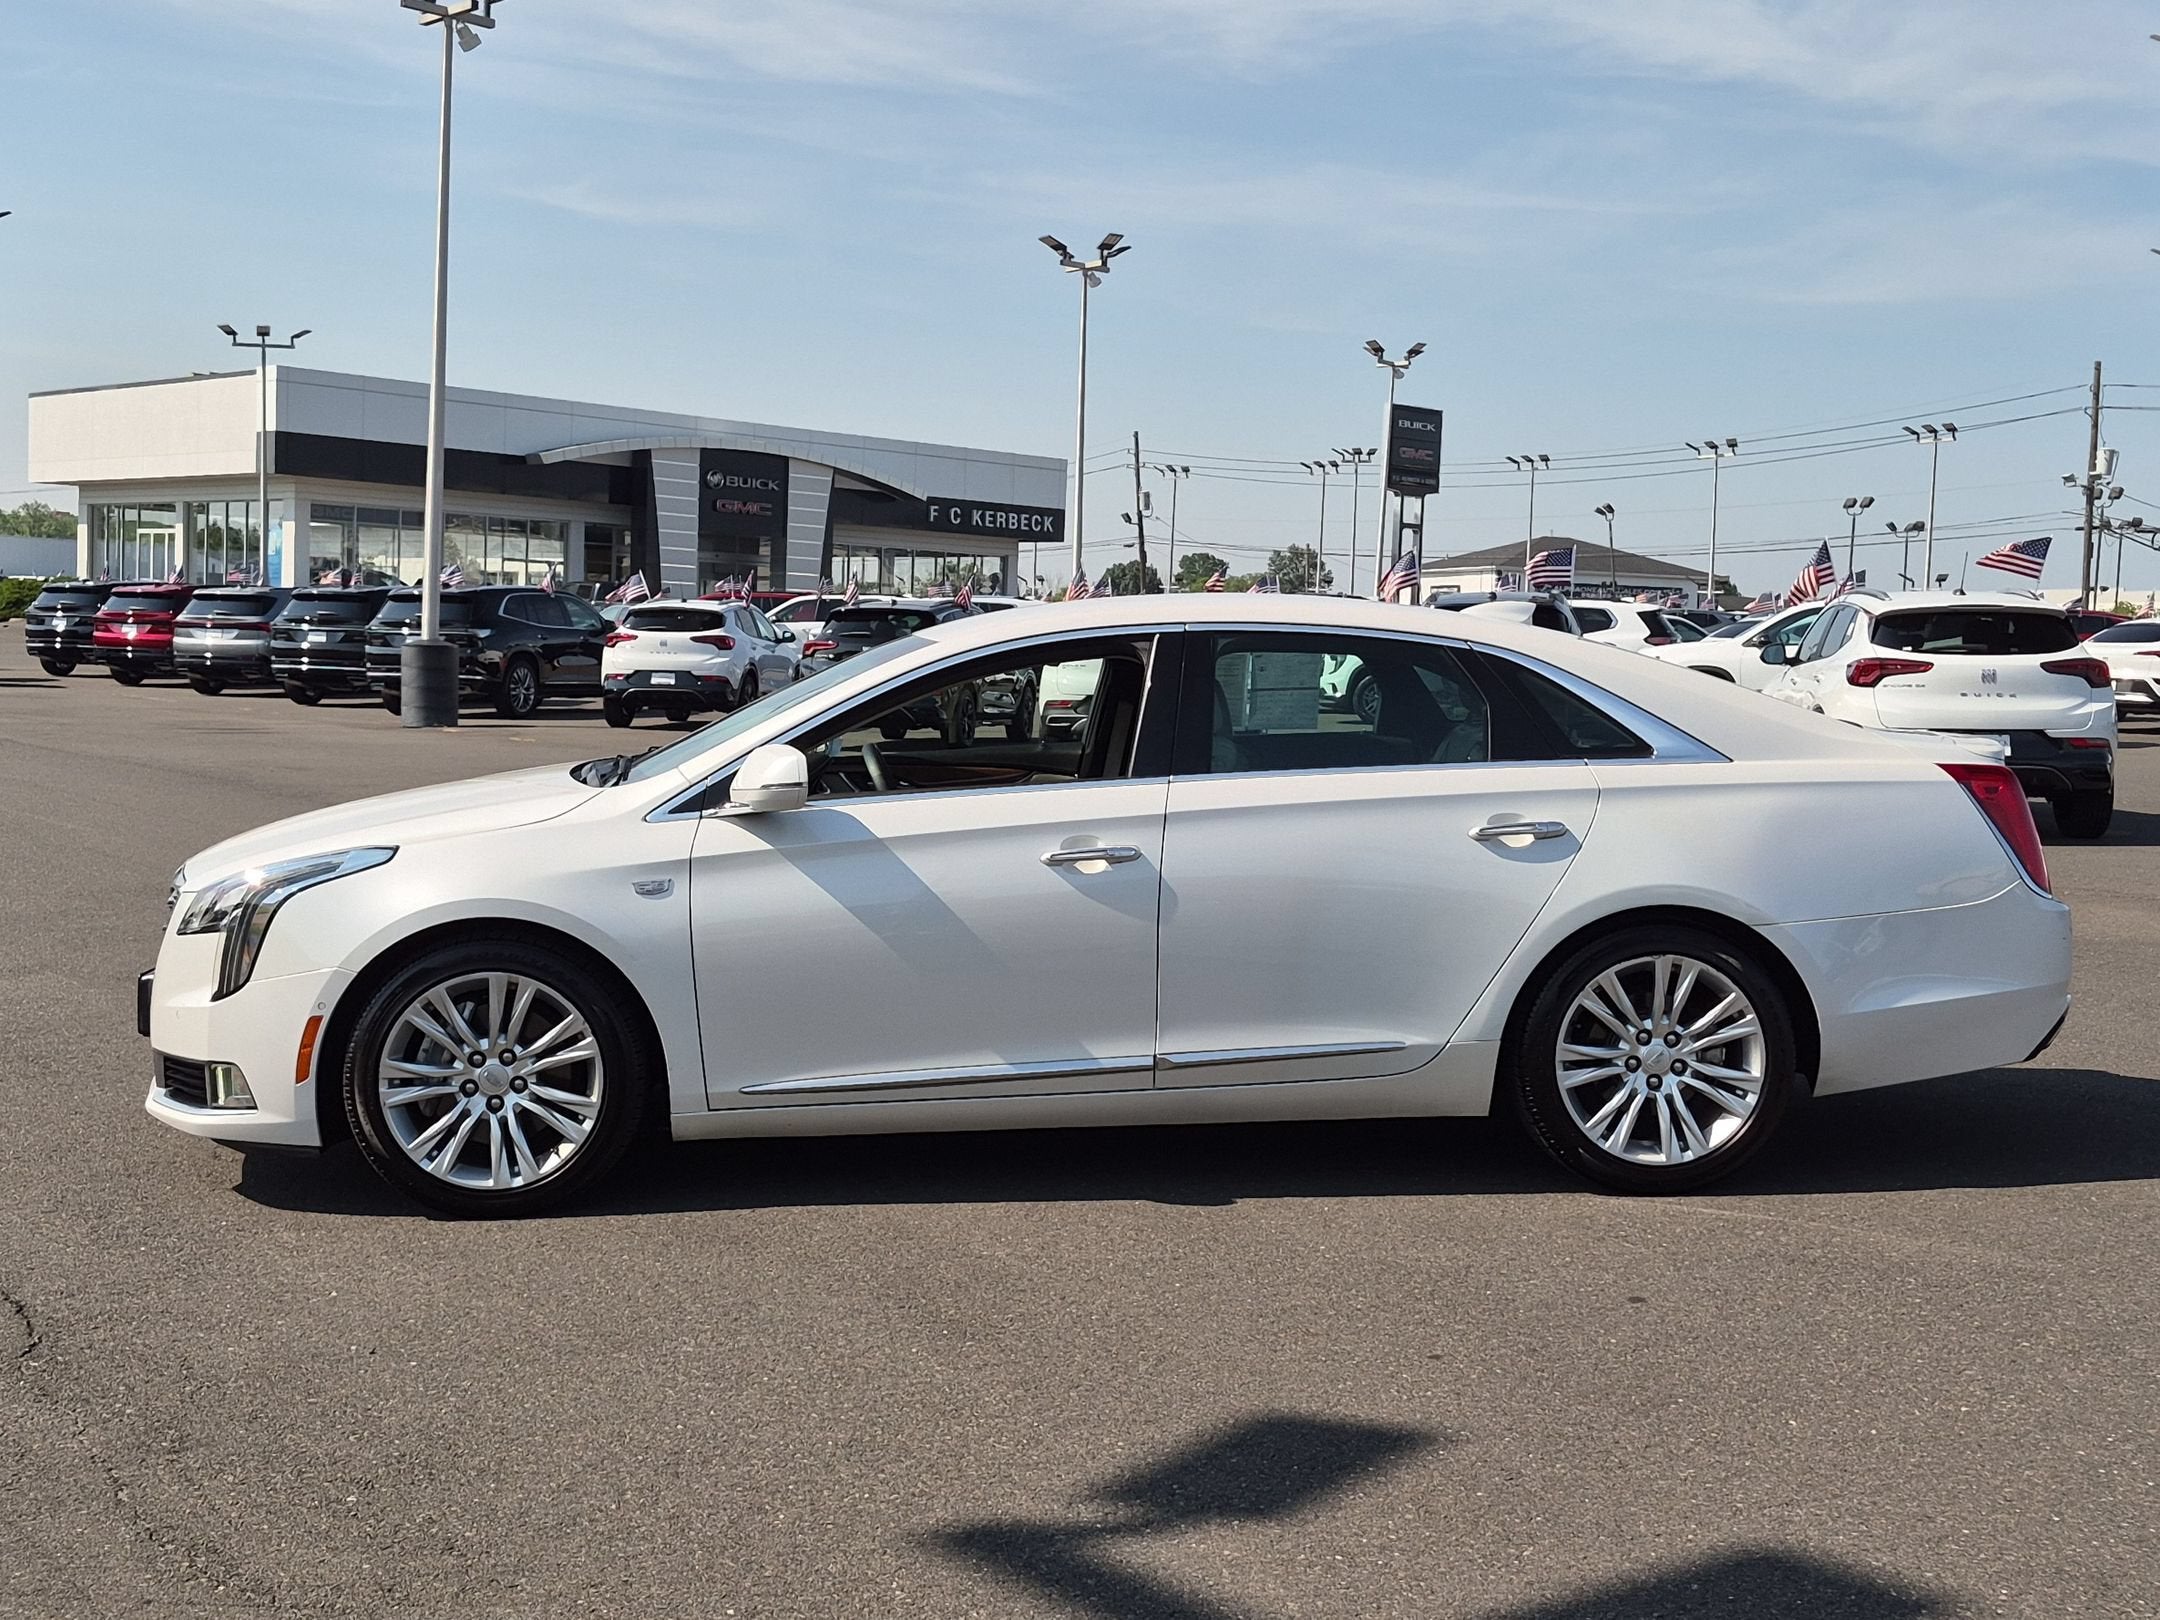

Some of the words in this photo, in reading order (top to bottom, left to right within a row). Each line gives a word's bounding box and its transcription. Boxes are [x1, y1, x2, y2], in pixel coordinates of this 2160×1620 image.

[1398, 419, 1436, 432] BUICK
[1399, 446, 1434, 461] GMC
[725, 475, 780, 491] BUICK
[716, 499, 773, 516] GMC
[929, 505, 939, 522] F
[950, 507, 961, 524] C
[972, 509, 1054, 532] KERBECK
